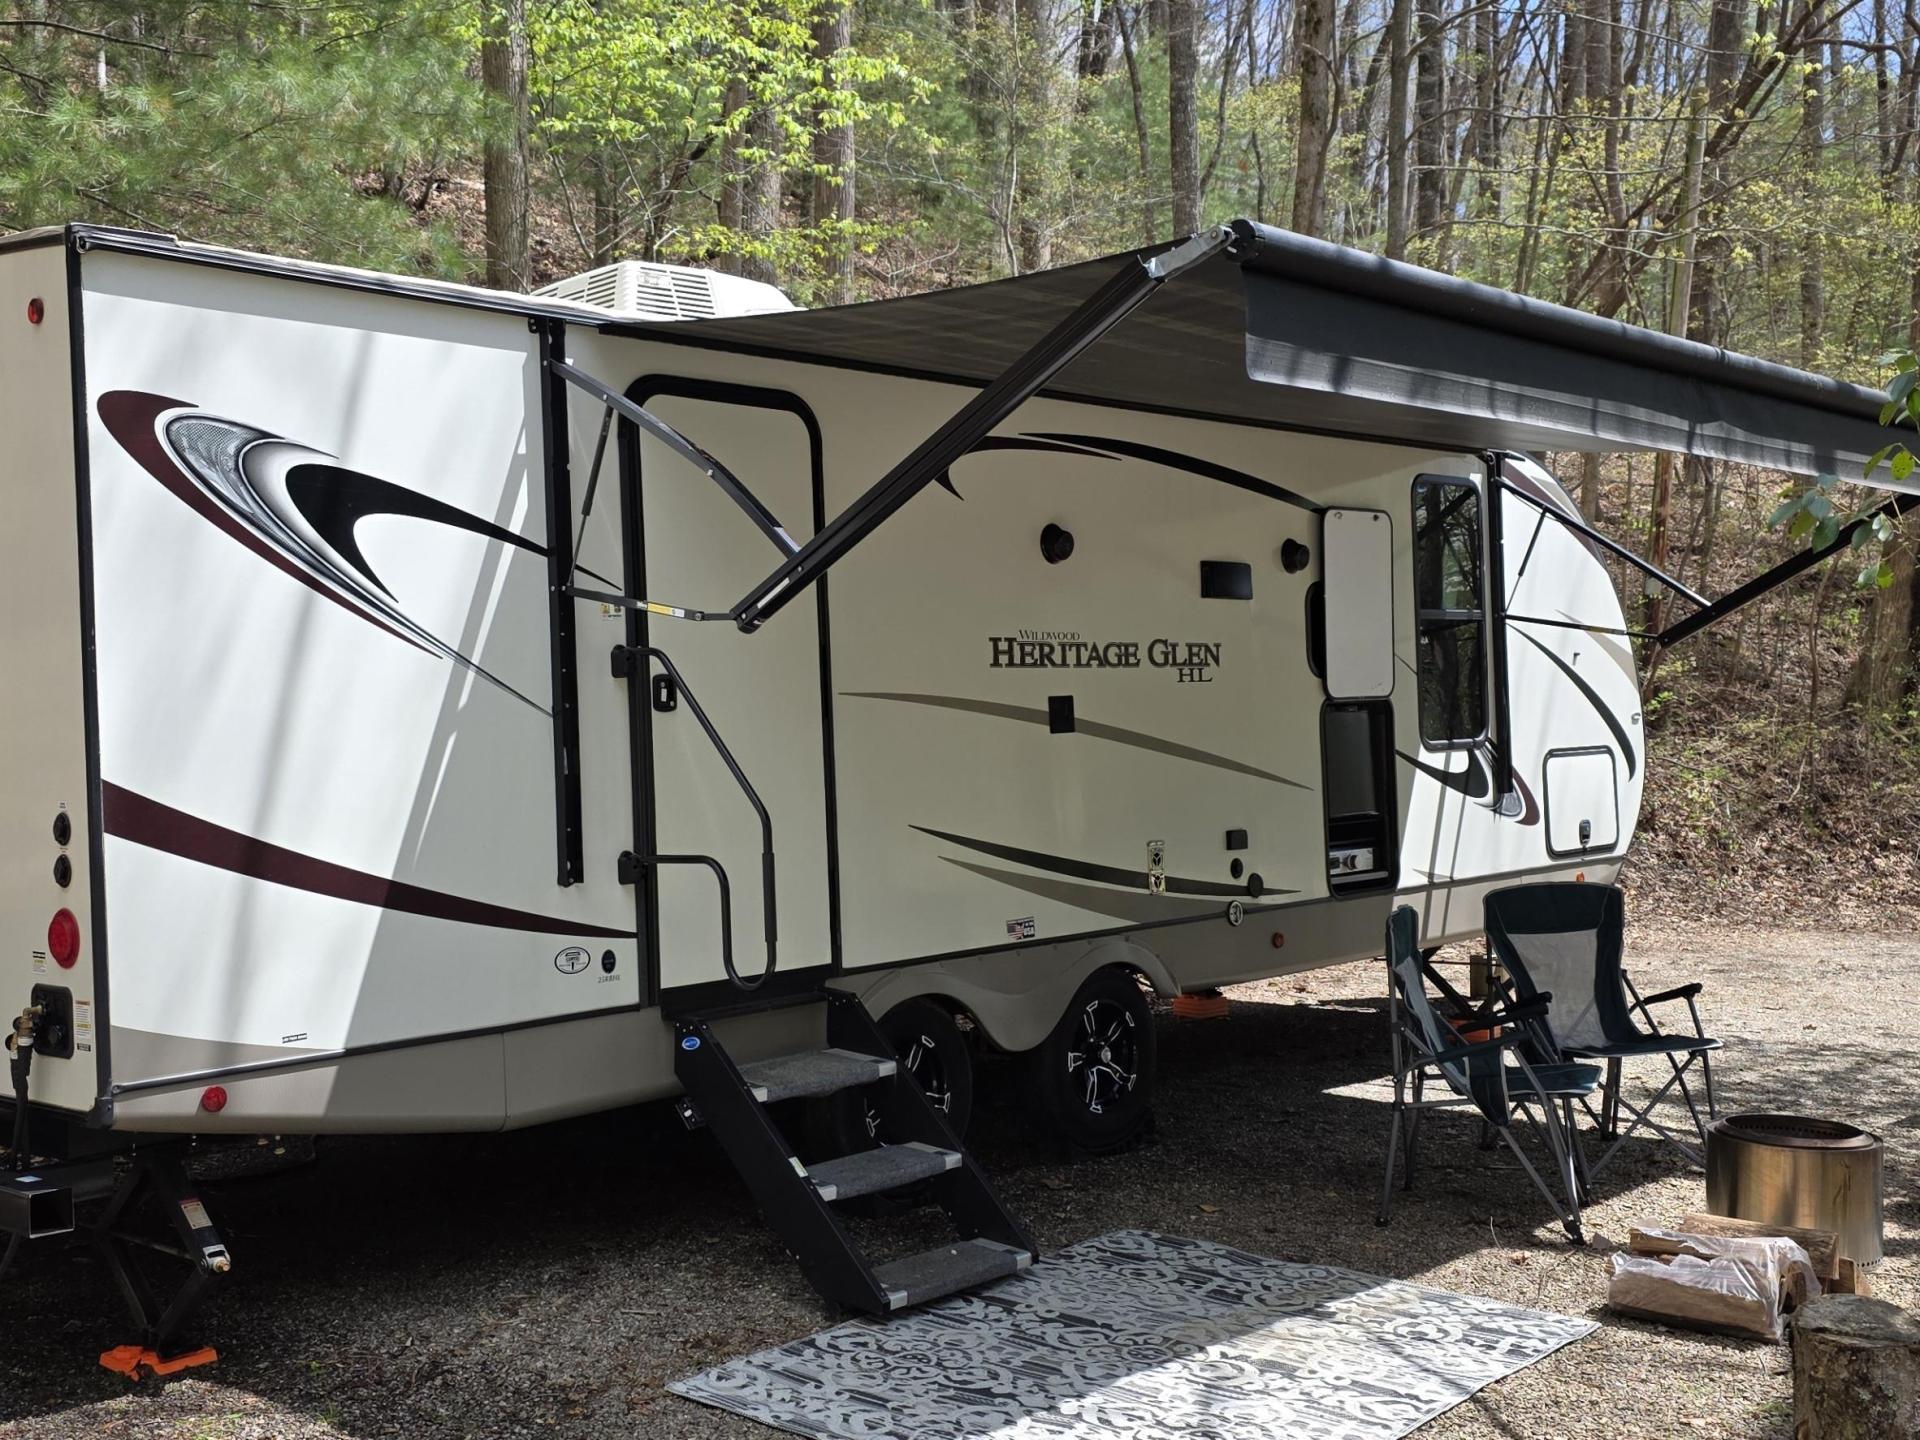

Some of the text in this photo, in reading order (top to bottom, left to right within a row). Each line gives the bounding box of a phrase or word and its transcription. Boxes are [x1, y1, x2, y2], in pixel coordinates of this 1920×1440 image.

[1018, 629, 1080, 641] WILDWOOD
[988, 637, 1222, 668] HERITAGE GLEN
[1177, 668, 1213, 683] HL
